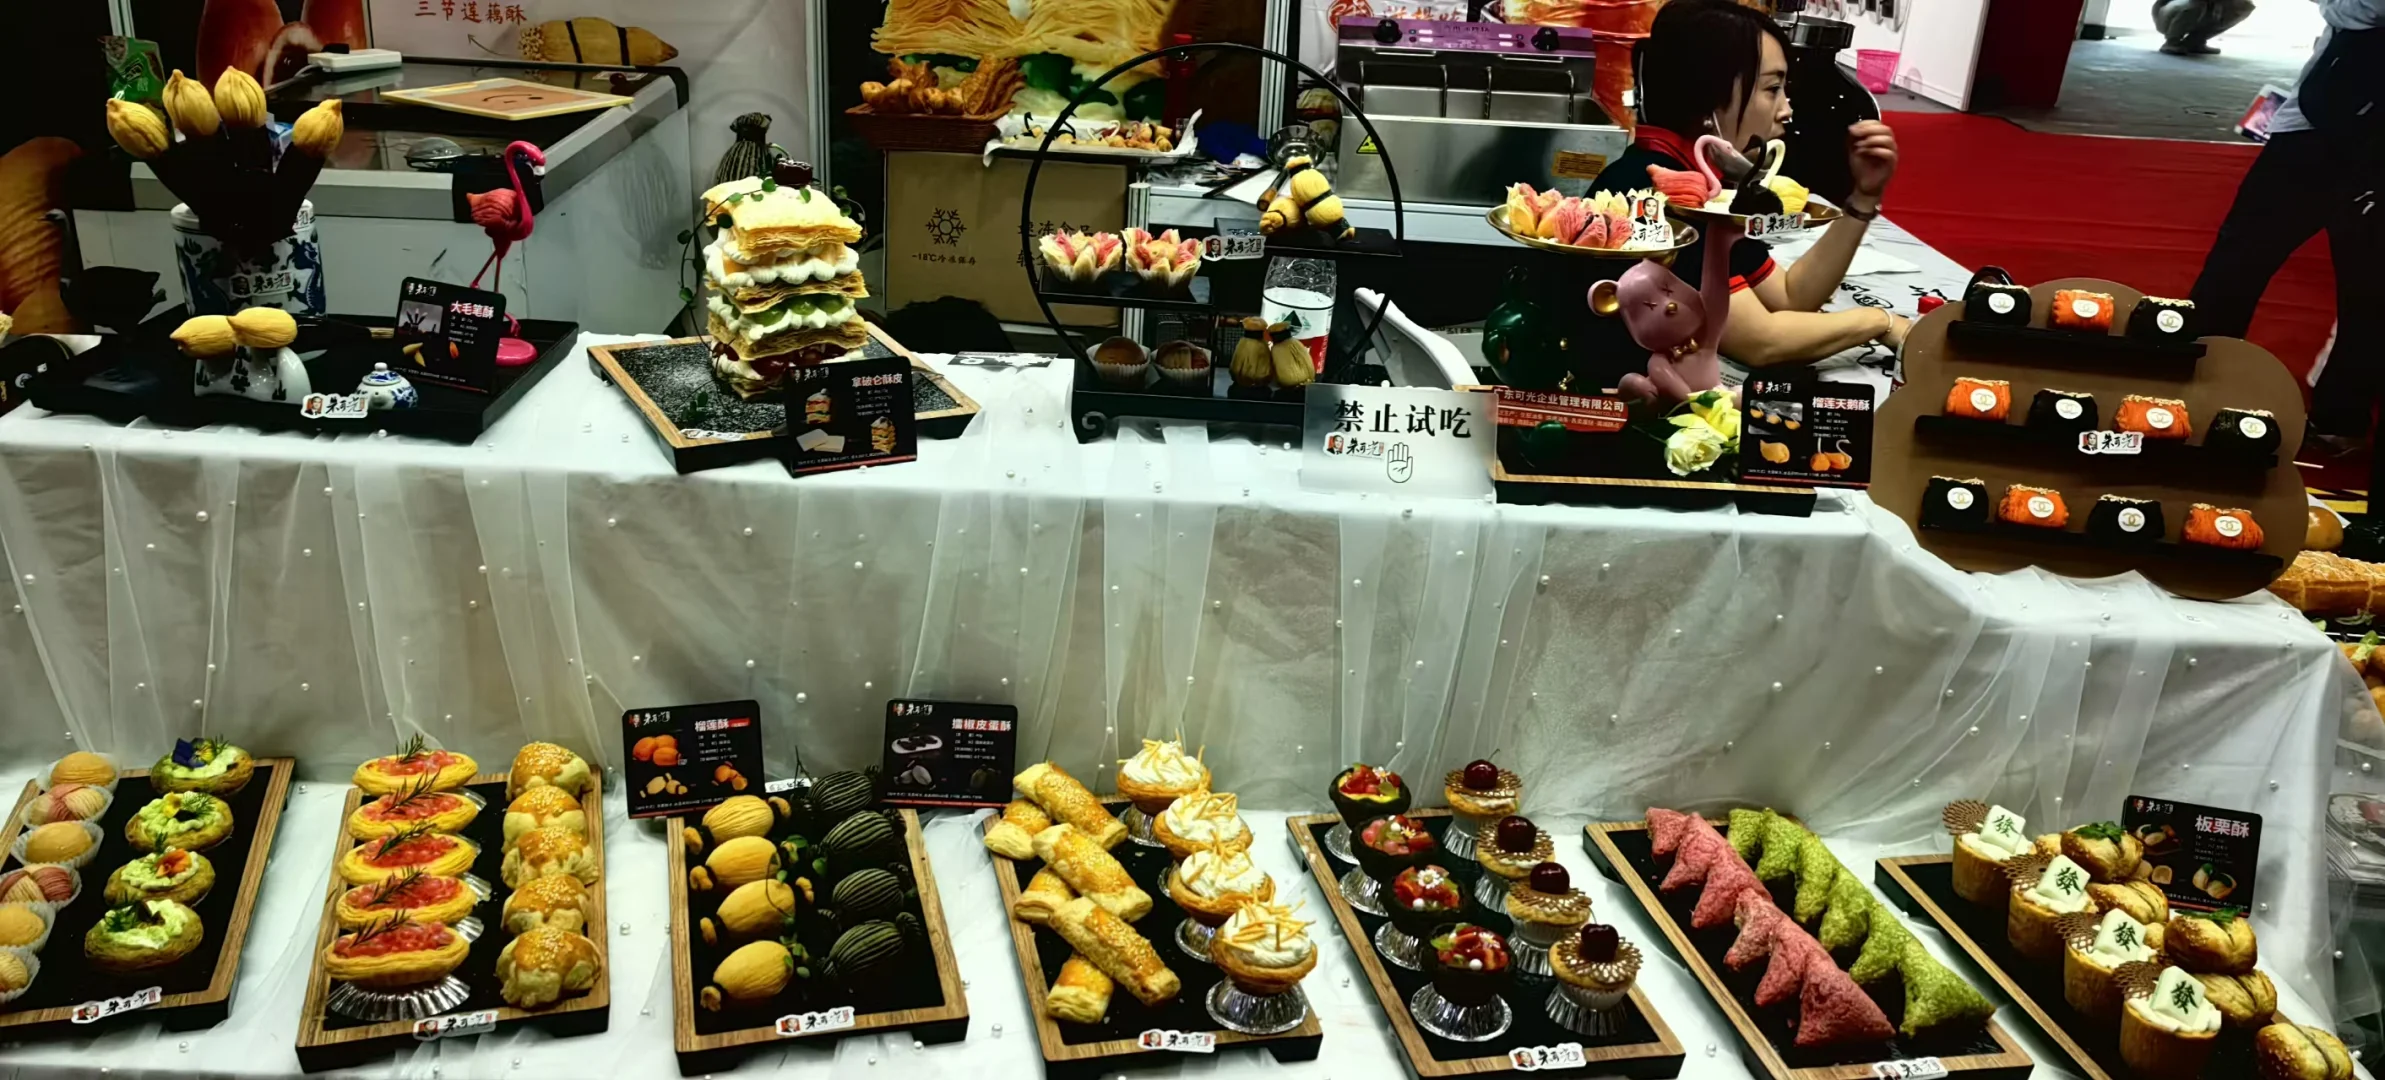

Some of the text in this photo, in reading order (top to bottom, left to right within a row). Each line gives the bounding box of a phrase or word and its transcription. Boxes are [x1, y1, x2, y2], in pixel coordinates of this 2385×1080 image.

[414, 1, 527, 25] 三节莲藕酥
[450, 301, 494, 319] 大毛笔酥
[851, 373, 903, 388] 拿破仑酥皮
[1811, 396, 1870, 412] 榴莲天鹅酥
[1334, 399, 1472, 438] 禁止试吃
[694, 718, 729, 732] 榴莲酥
[2194, 815, 2251, 838] 板栗酥
[2055, 866, 2082, 895] 發
[2112, 921, 2139, 951] 發
[2170, 980, 2198, 1015] 發
